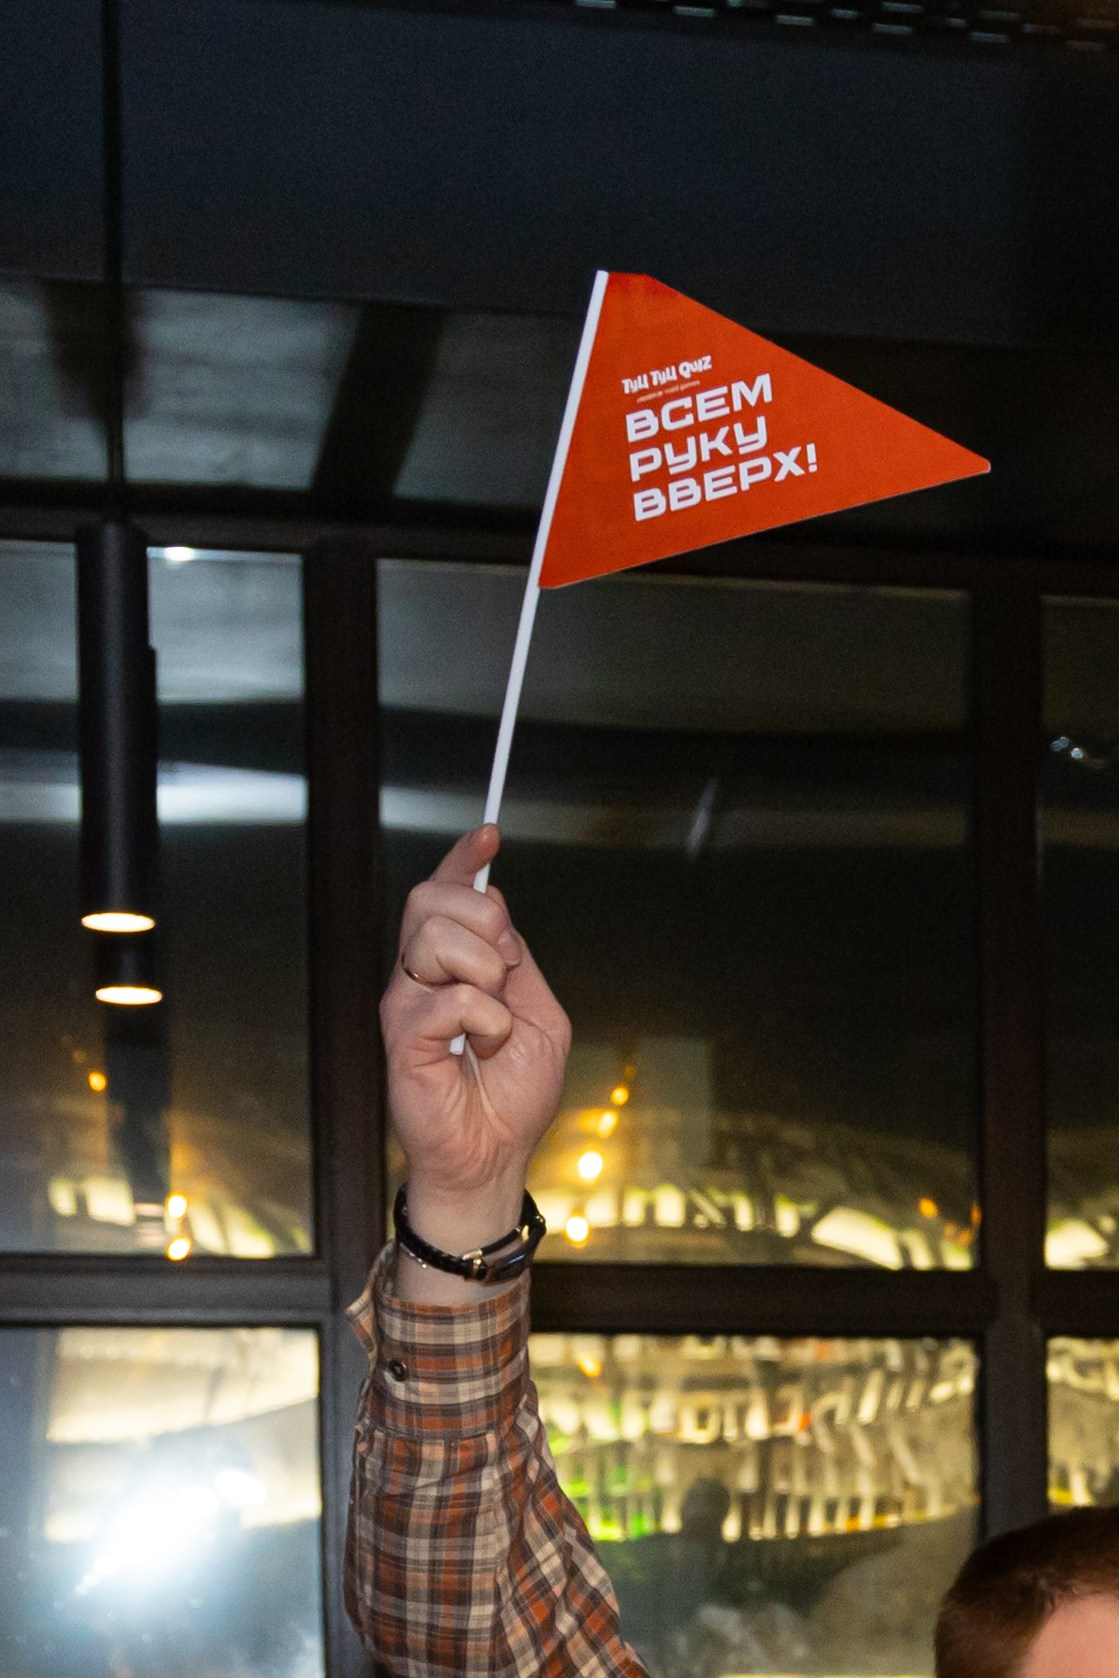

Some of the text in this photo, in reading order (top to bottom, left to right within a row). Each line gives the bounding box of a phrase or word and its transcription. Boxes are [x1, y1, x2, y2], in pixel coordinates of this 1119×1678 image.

[625, 373, 773, 443] ВСЕМ
[629, 415, 767, 482] РУКУ
[633, 442, 818, 522] ВВЕРХ!
